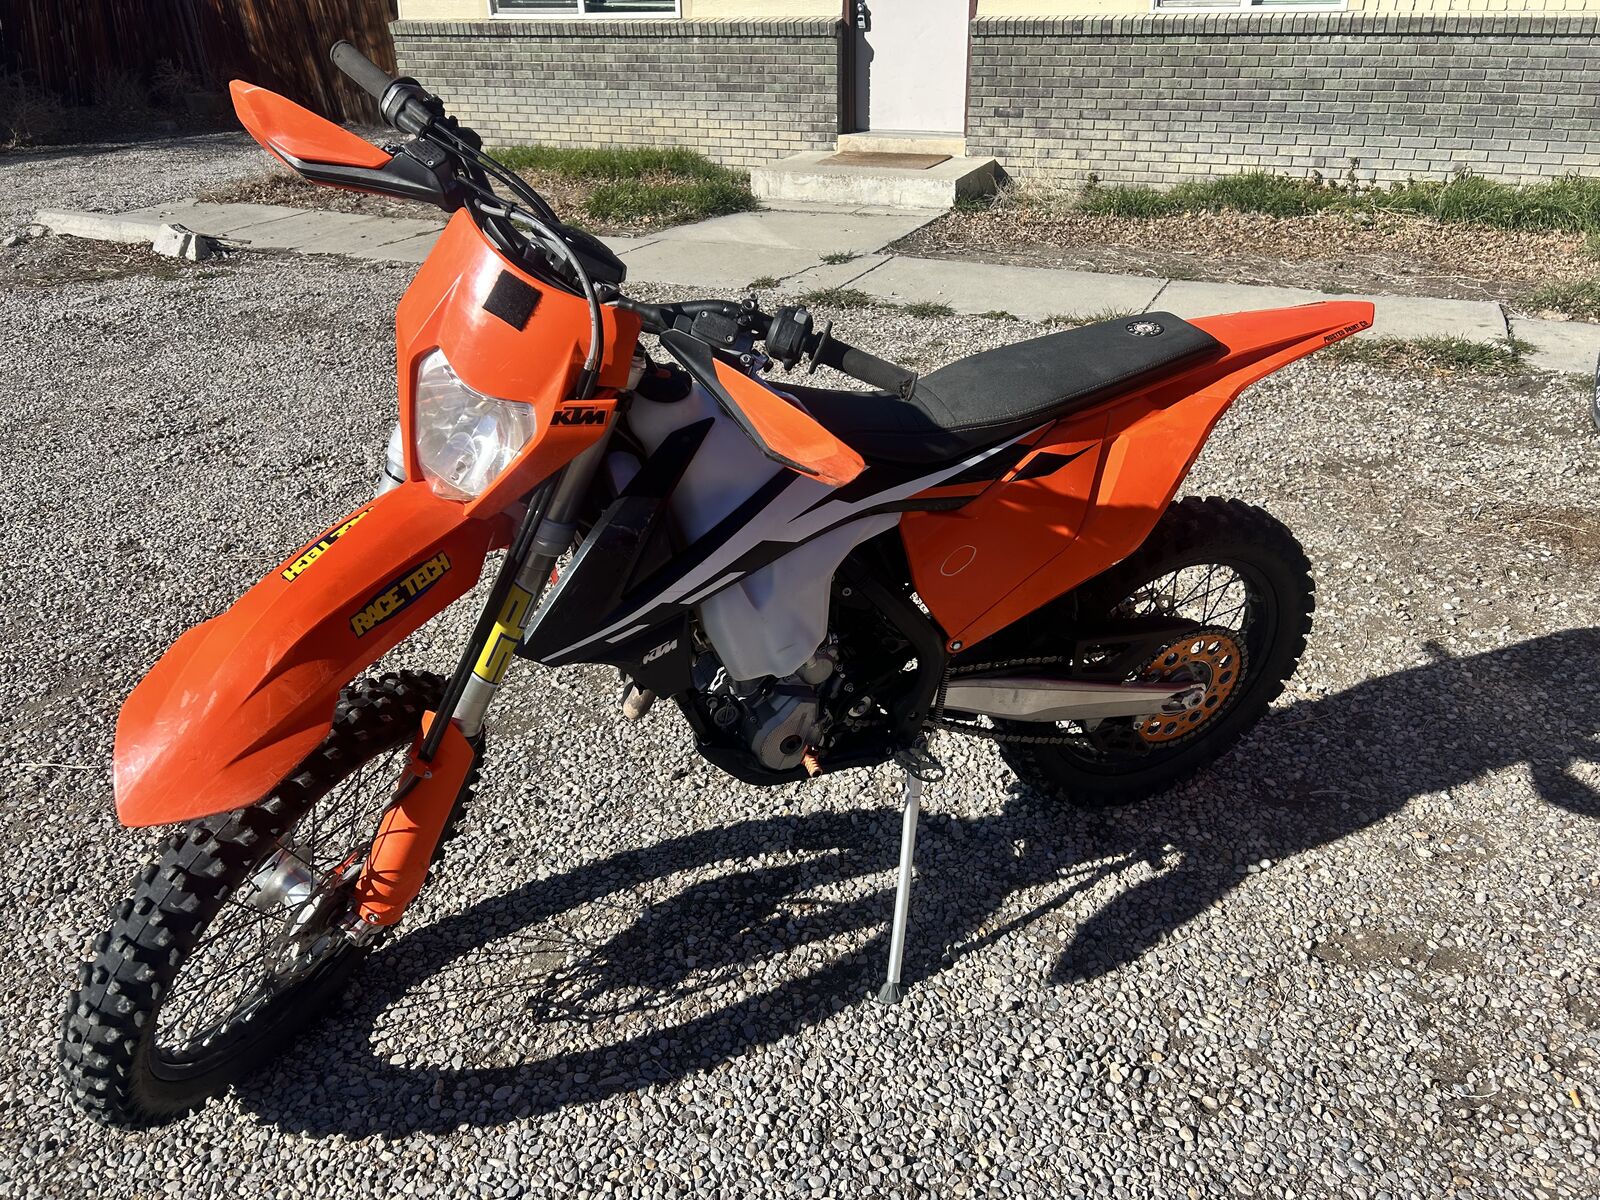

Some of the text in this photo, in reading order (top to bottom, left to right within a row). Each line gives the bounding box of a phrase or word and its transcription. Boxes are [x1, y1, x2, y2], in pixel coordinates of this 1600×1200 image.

[550, 406, 607, 425] KTM
[350, 551, 451, 637] RACE TECH
[642, 639, 678, 665] KTM
